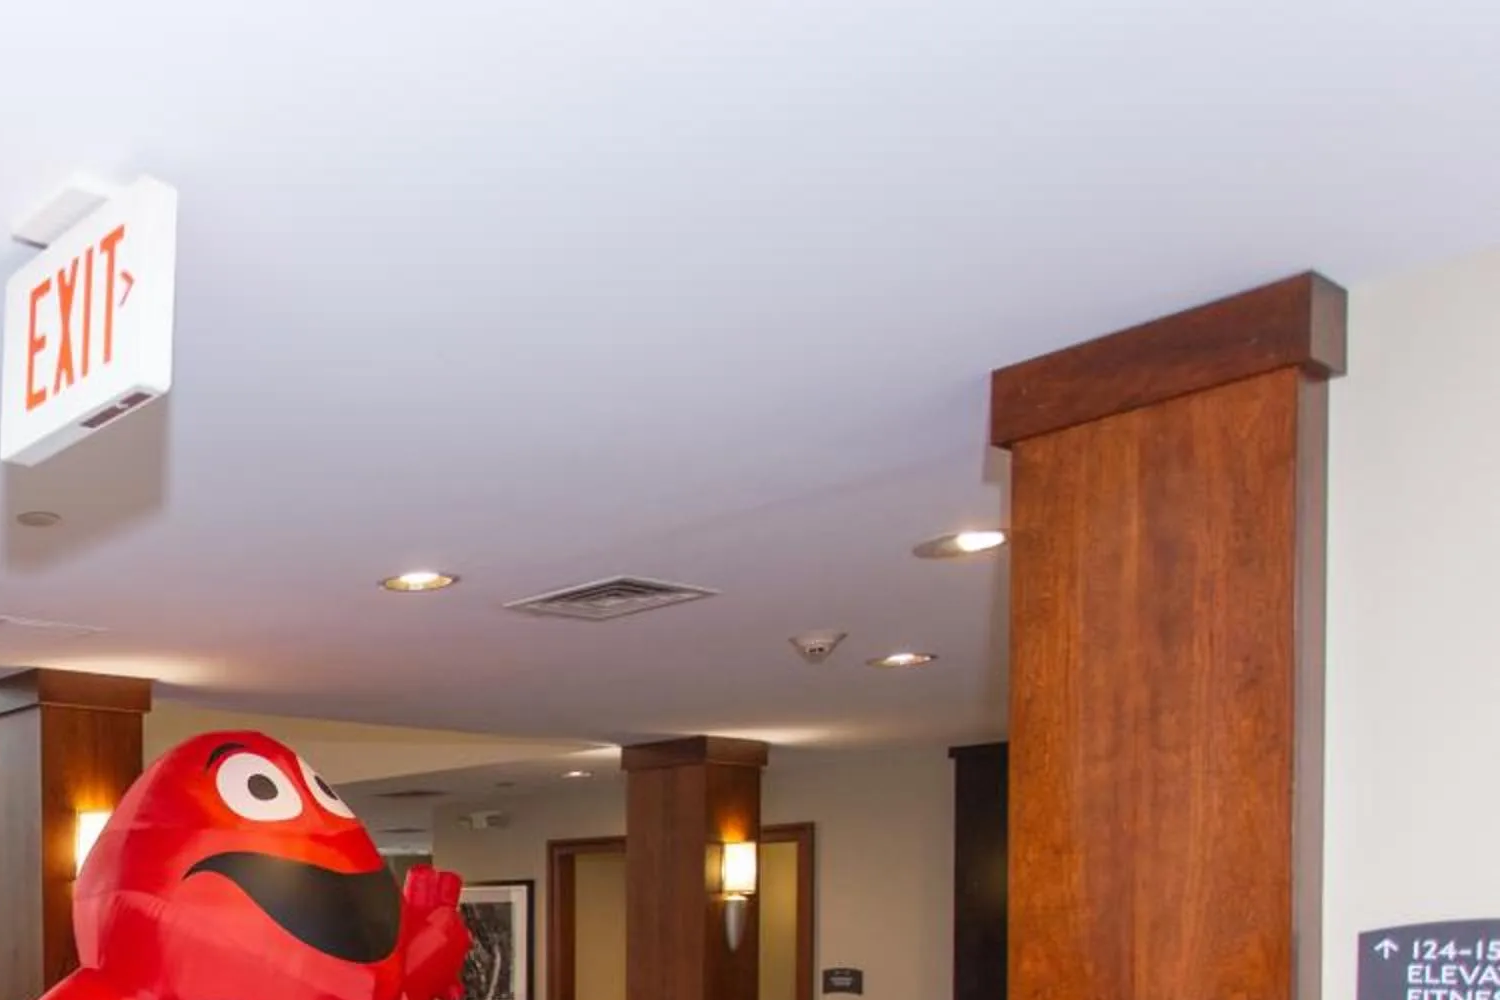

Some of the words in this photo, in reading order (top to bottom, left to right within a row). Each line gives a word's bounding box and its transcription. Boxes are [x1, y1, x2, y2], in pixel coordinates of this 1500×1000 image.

[25, 223, 125, 412] EXIT
[1411, 939, 1500, 961] 124-15
[1406, 964, 1500, 986] ELEVA
